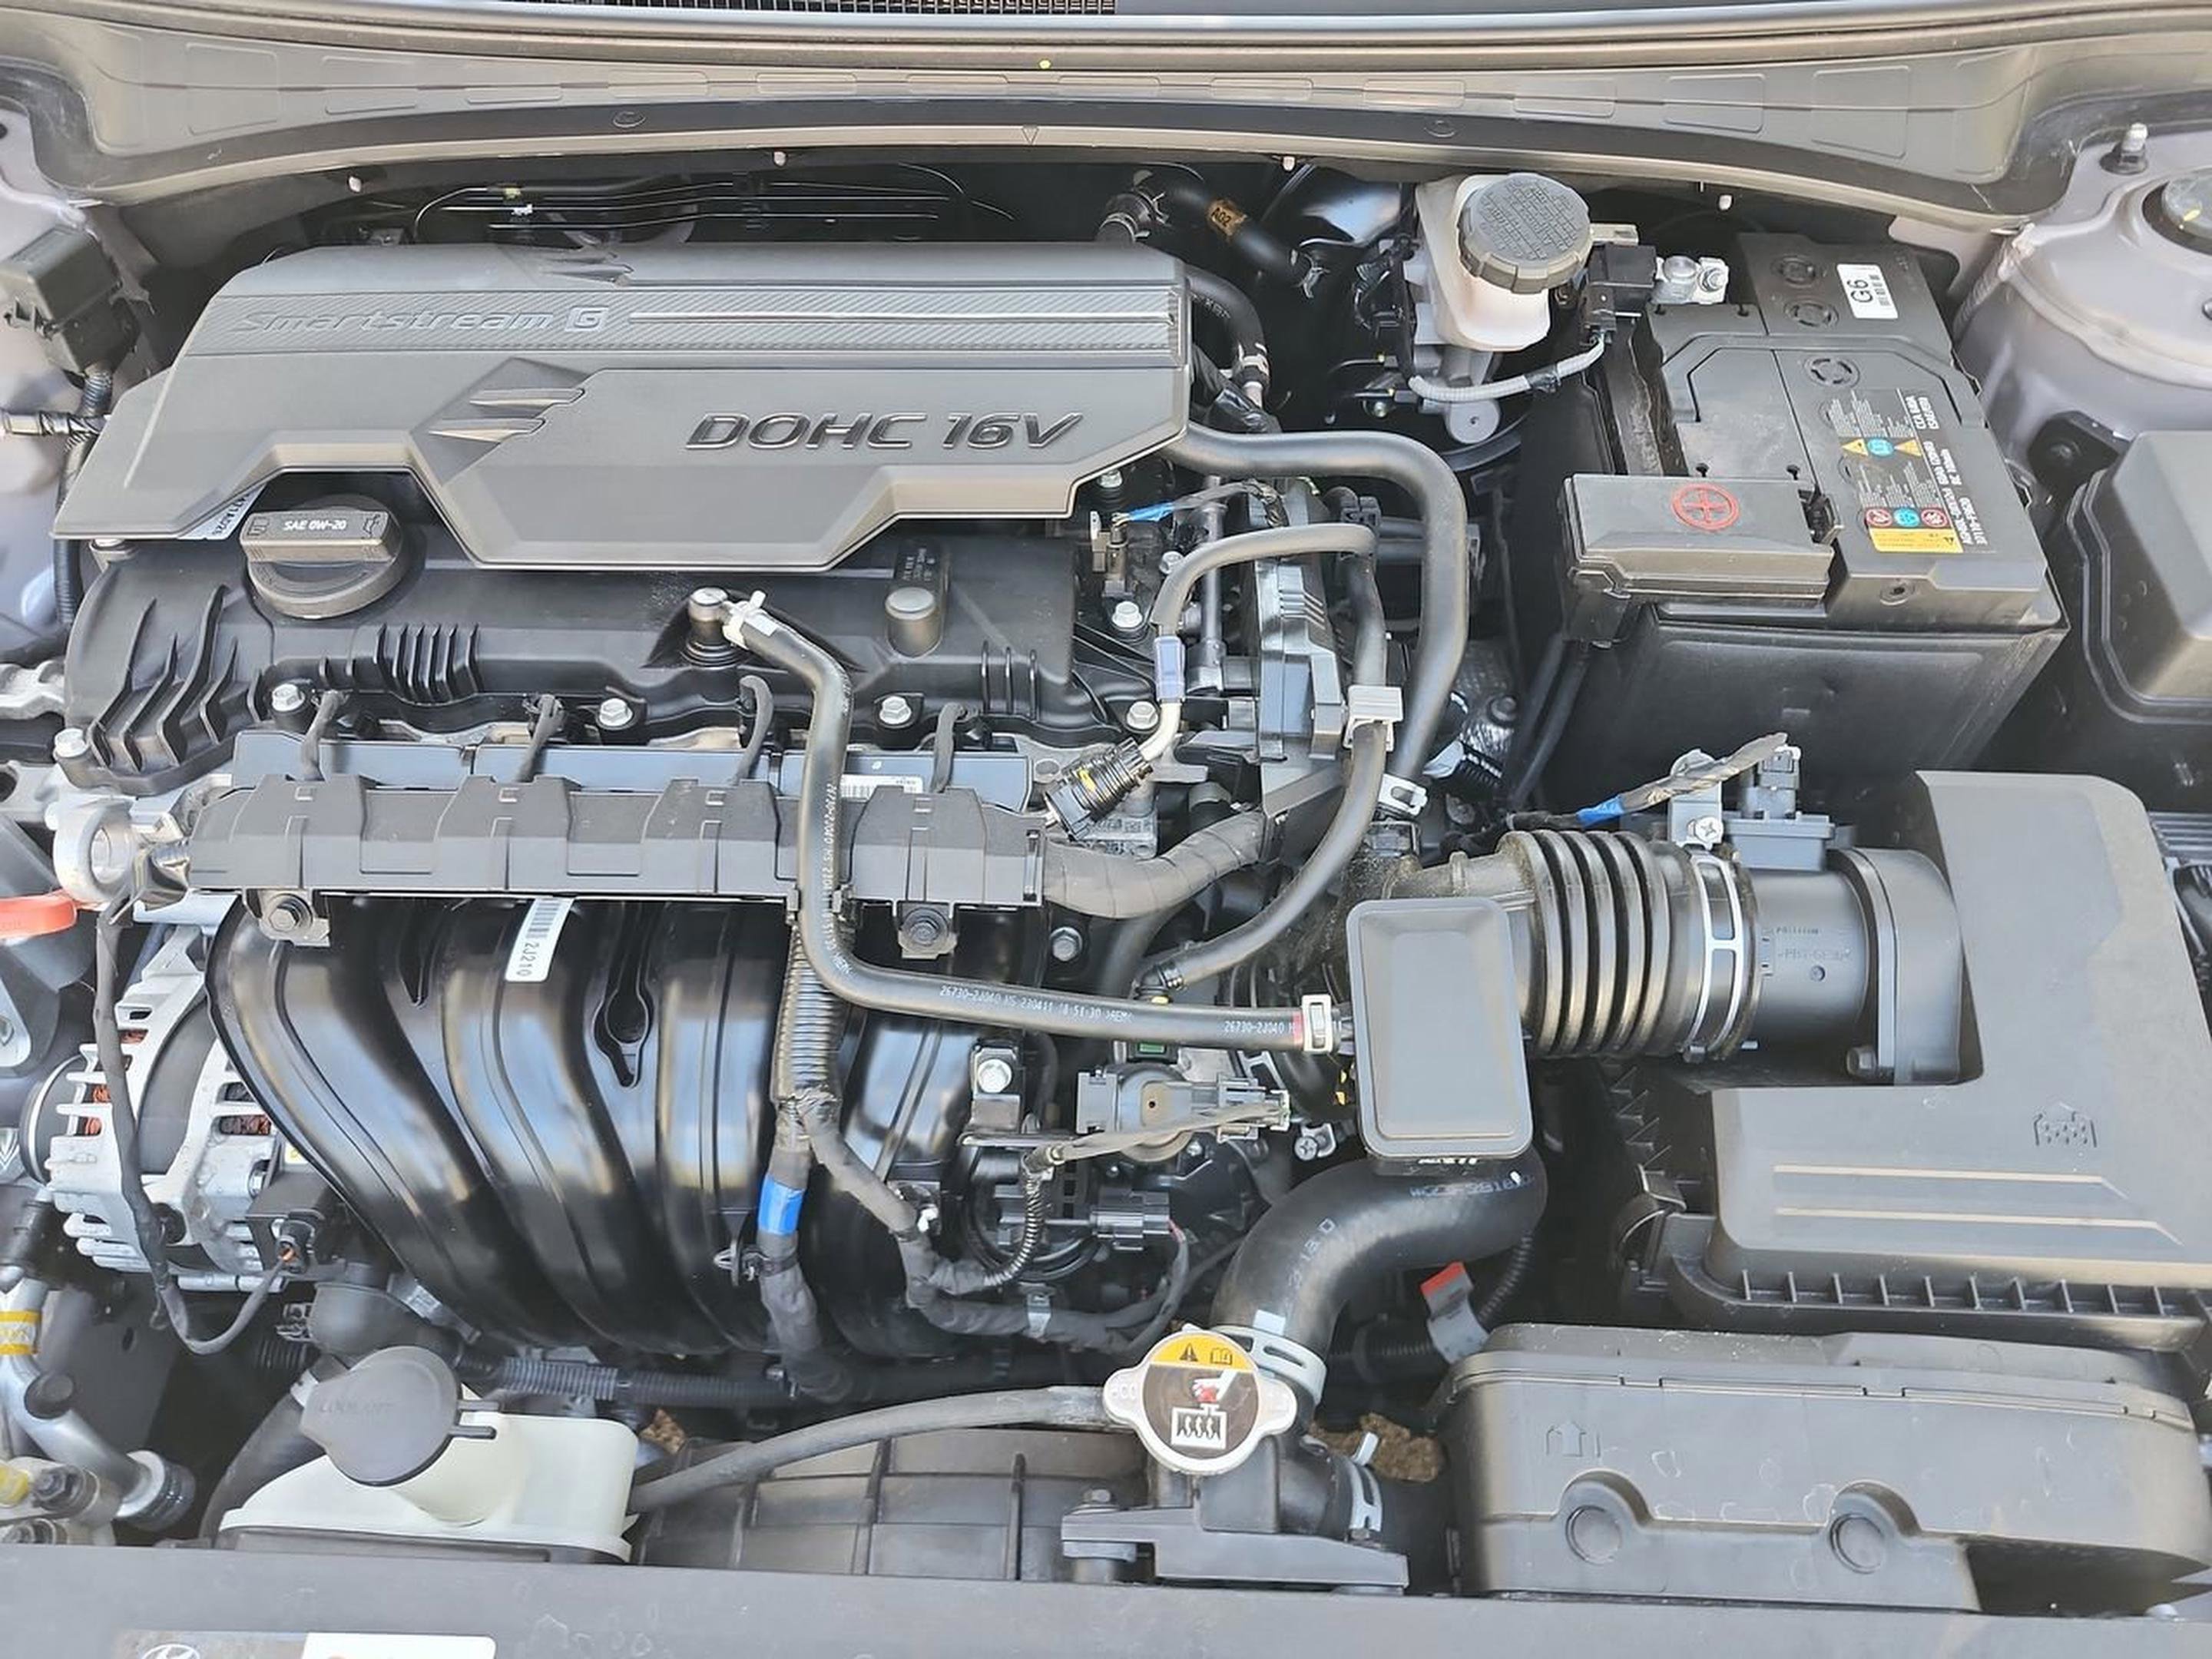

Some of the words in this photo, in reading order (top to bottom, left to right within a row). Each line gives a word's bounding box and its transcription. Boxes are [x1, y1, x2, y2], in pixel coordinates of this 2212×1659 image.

[1846, 279, 1873, 303] G6
[240, 309, 554, 332] Smartstream
[568, 307, 606, 331] G
[686, 412, 927, 449] DOHC
[942, 412, 1082, 449] 16V
[283, 520, 307, 531] SAE
[309, 518, 347, 530] 0W-20
[516, 942, 540, 977] 2J210
